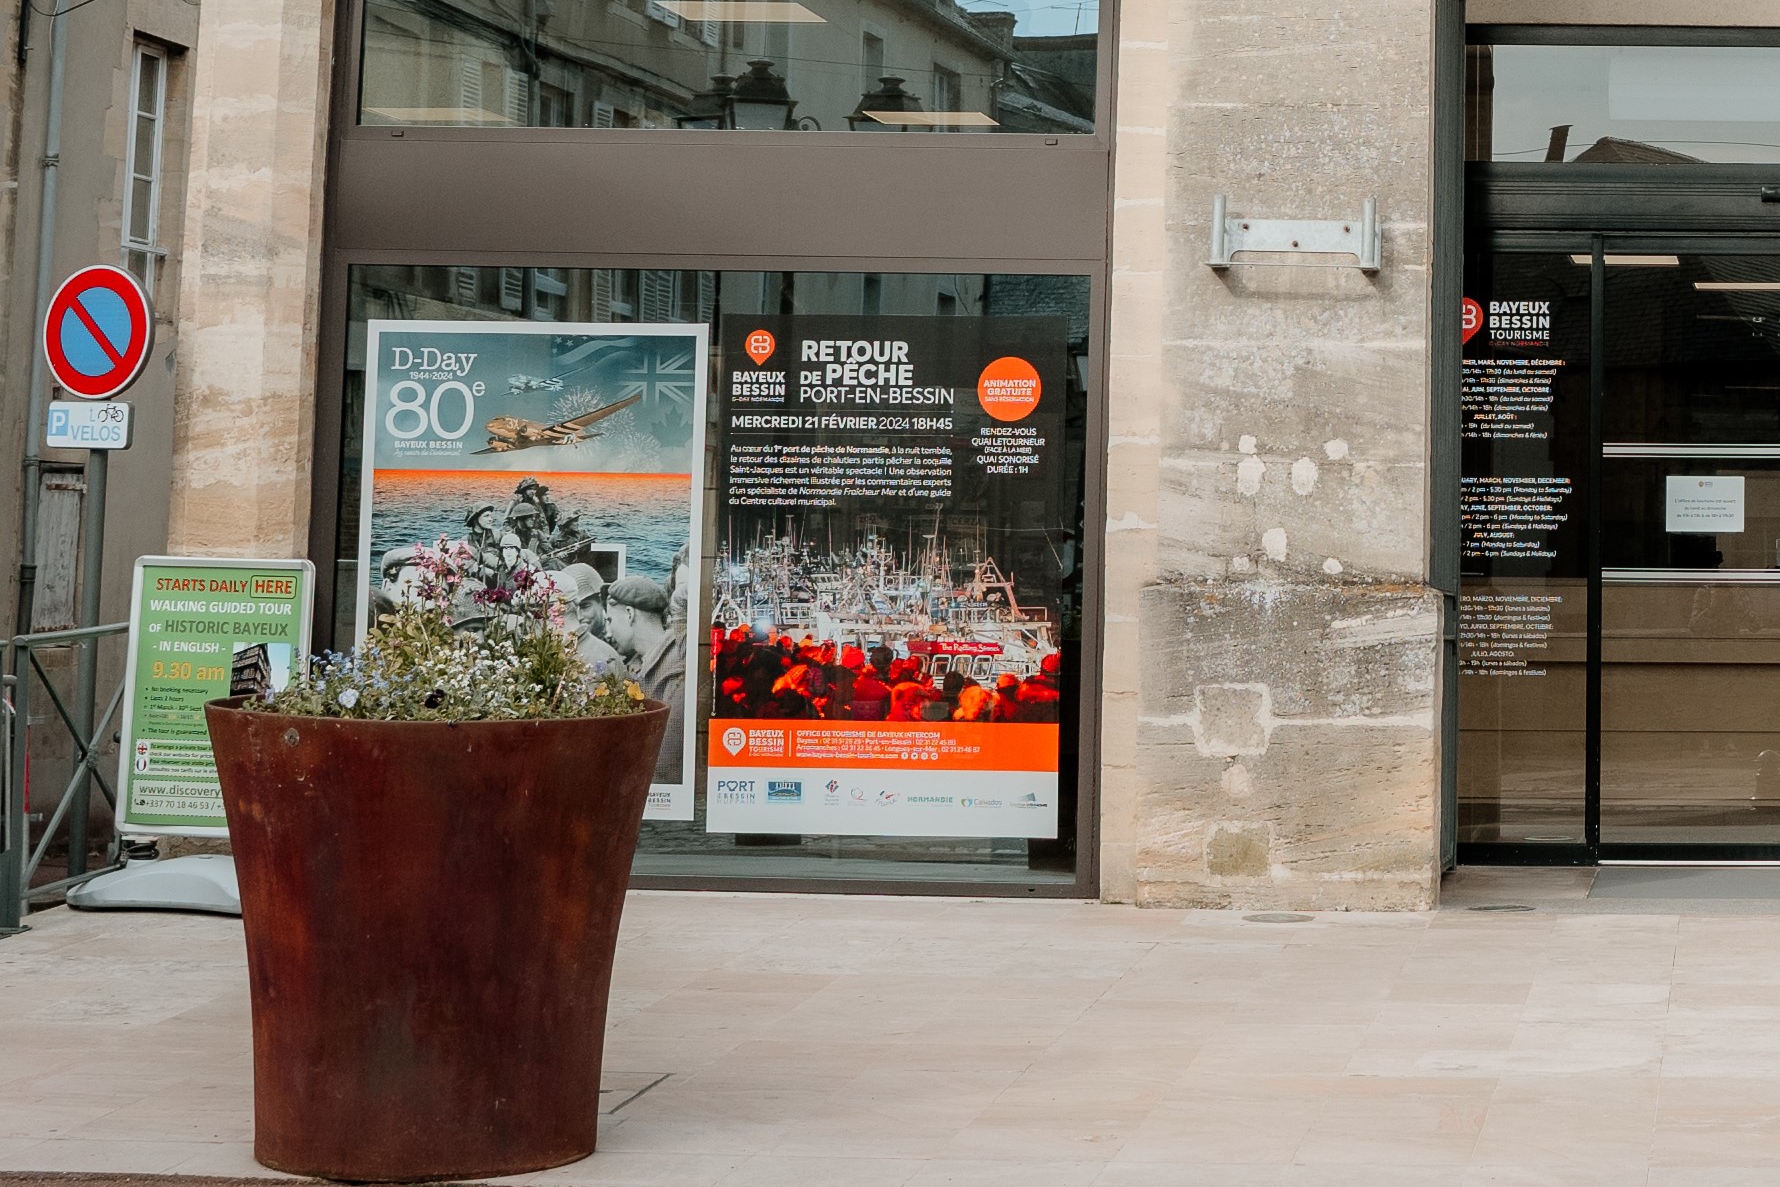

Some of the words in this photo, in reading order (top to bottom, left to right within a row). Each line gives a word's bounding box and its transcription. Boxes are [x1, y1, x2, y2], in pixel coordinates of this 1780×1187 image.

[1490, 302, 1549, 313] BAYEUX
[1490, 316, 1549, 328] BESSIN
[1490, 330, 1549, 339] TOURISME
[801, 340, 909, 362] RETOUR
[391, 348, 477, 376] D-Day
[732, 371, 786, 383] BAYEUX
[800, 371, 822, 385] DE
[826, 358, 914, 386] PÊCHE
[984, 379, 1036, 388] ANIMATION
[732, 384, 786, 396] BESSIN
[800, 387, 954, 405] PORT-EN-BESSIN
[731, 416, 802, 428] MERCREDI
[805, 417, 819, 429] 21
[822, 414, 877, 429] FÉVRIER
[879, 417, 910, 430] 2024
[912, 417, 953, 430] 18H45
[71, 426, 121, 441] VELOS
[972, 438, 991, 446] QUAI
[993, 438, 1045, 446] LETOURNEUR
[977, 456, 997, 464] QUAI
[987, 464, 1013, 473] DURÉE
[156, 578, 206, 592] STARTS
[209, 580, 248, 593] DAILY
[254, 580, 293, 594] HERE
[150, 600, 206, 612] WALKING
[209, 601, 256, 614] GUIDED
[259, 603, 292, 615] TOUR
[150, 624, 162, 633] OF
[165, 620, 229, 634] HISTORIC
[233, 622, 289, 636] BAYEUX
[159, 641, 171, 651] IN
[173, 642, 219, 653] ENGLISH
[152, 661, 192, 679] 9.30
[196, 666, 225, 681] am
[749, 738, 784, 746] BESSIN
[166, 800, 175, 808] 70
